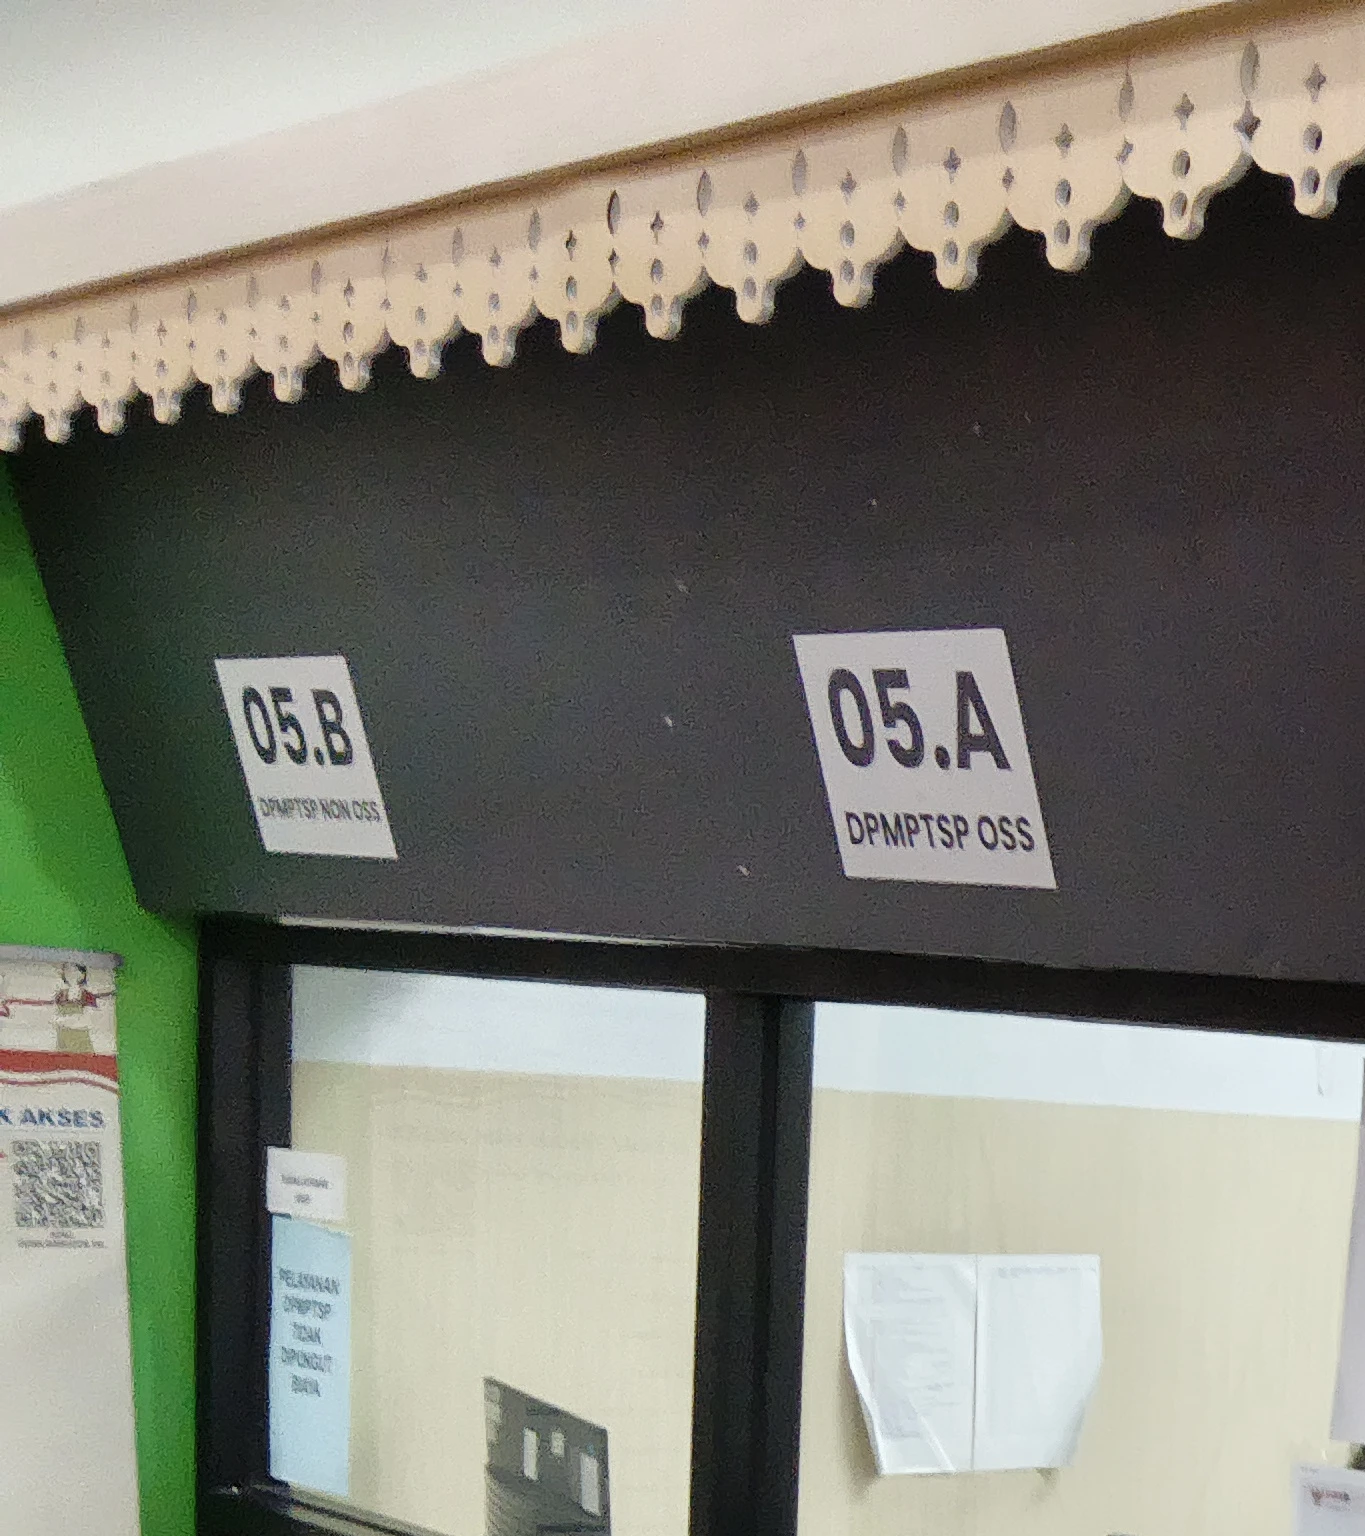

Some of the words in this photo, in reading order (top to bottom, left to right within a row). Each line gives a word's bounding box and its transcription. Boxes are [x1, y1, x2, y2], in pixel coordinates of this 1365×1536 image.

[241, 686, 353, 766] 05.B
[828, 668, 1012, 770] 05.A
[257, 796, 318, 819] DPMPTSP
[321, 799, 350, 820] NON
[352, 800, 381, 822] OSS
[845, 811, 969, 849] DPMPTSP
[977, 815, 1035, 851] OSS
[20, 1107, 105, 1129] AKSES
